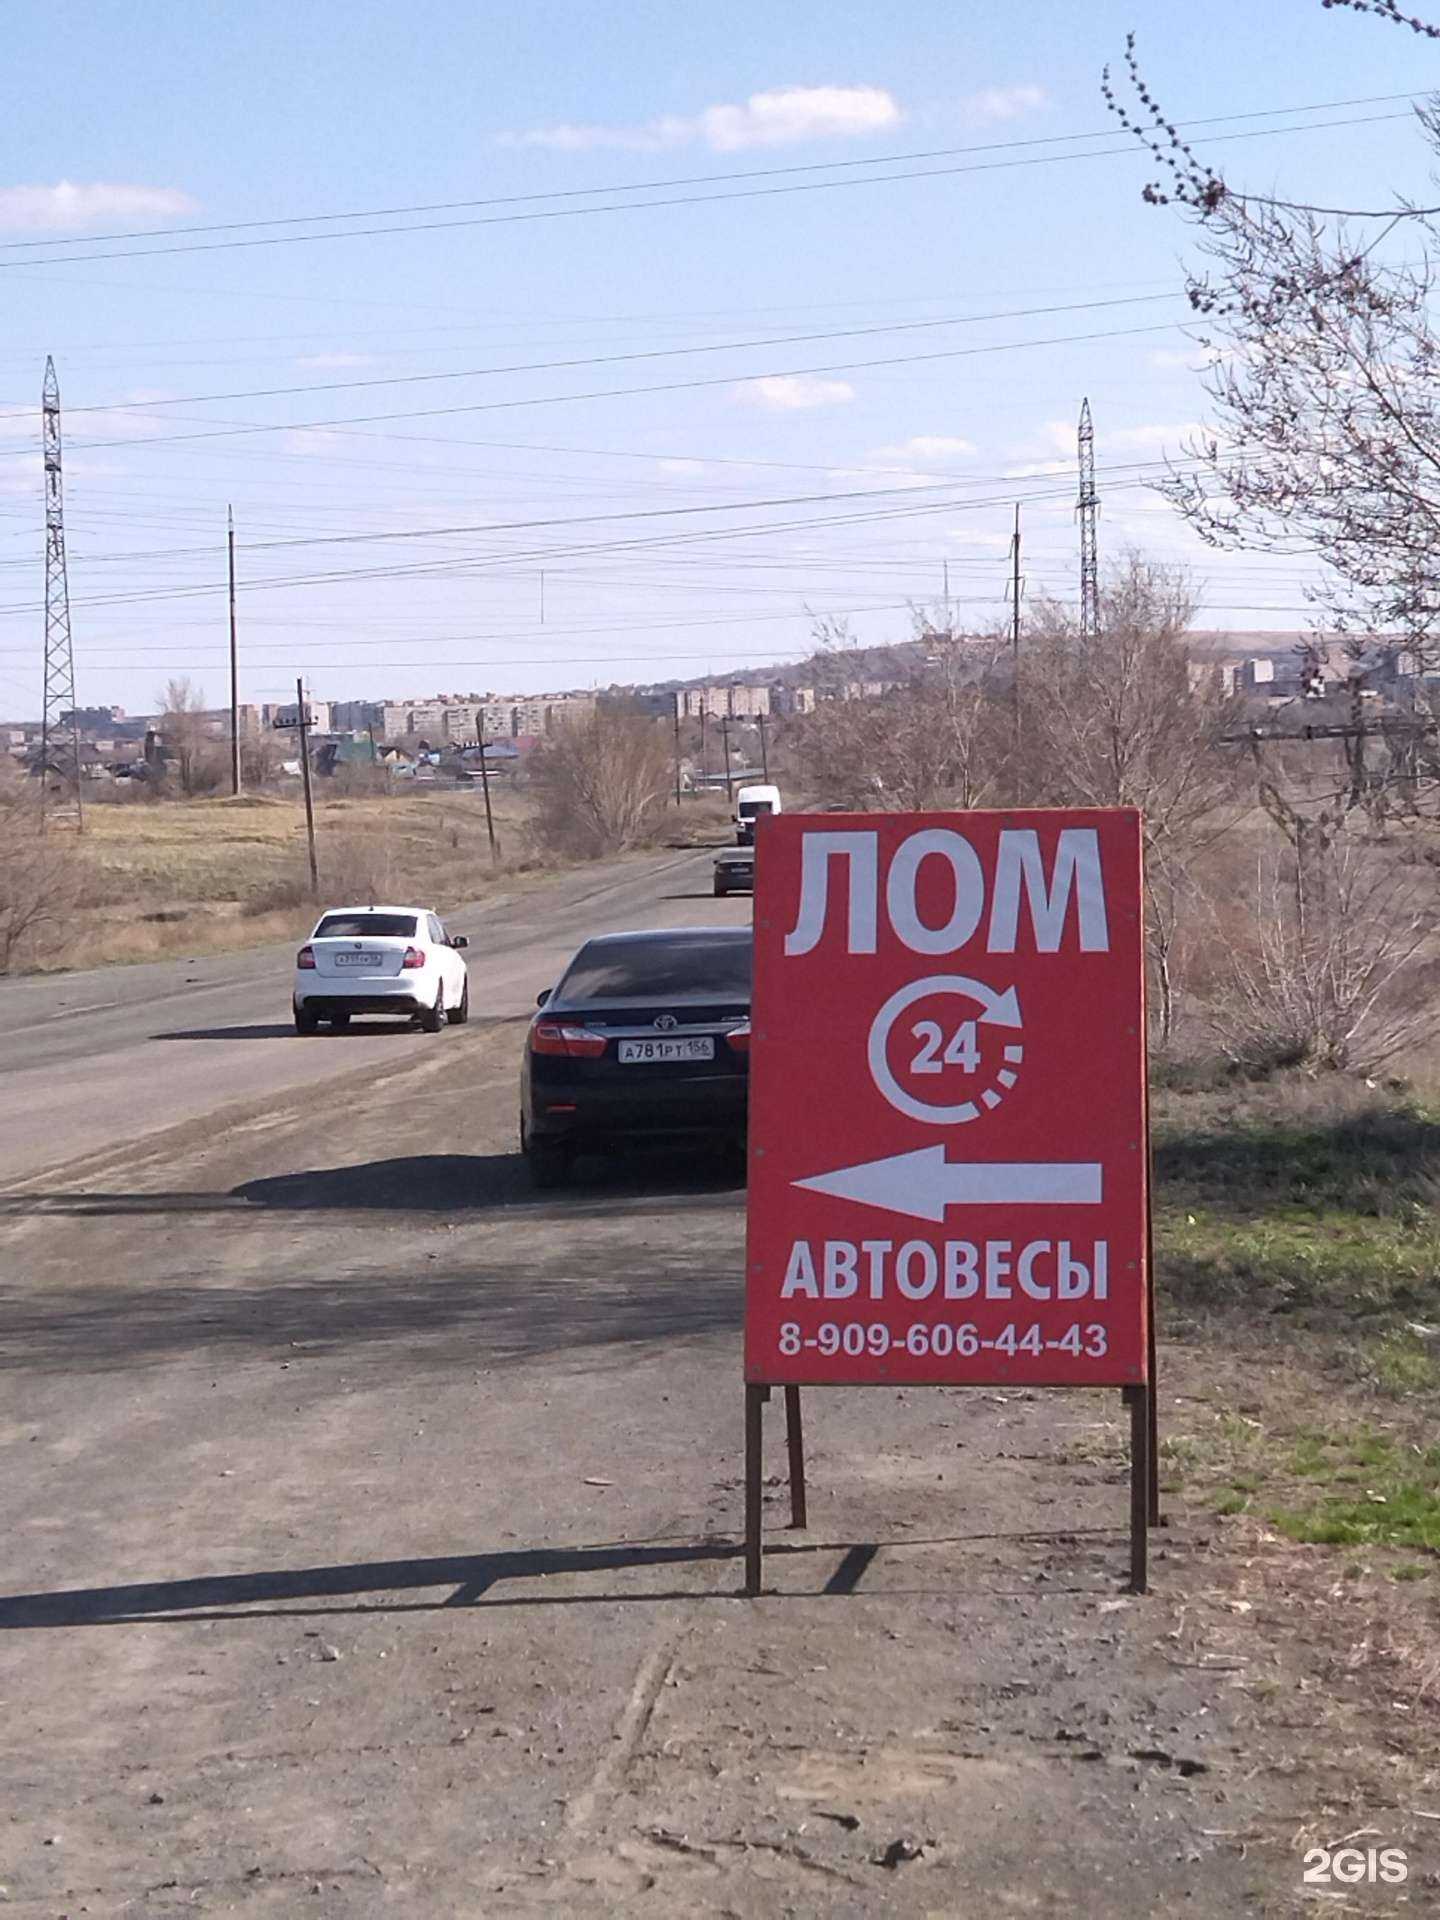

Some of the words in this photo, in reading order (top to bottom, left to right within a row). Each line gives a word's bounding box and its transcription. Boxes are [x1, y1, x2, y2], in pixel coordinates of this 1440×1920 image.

[784, 828, 1109, 956] ЛОМ
[910, 1020, 981, 1074] 24
[780, 1240, 1107, 1300] АВТОВЕСЫ
[778, 1323, 1107, 1357] 8-909-606-44-43
